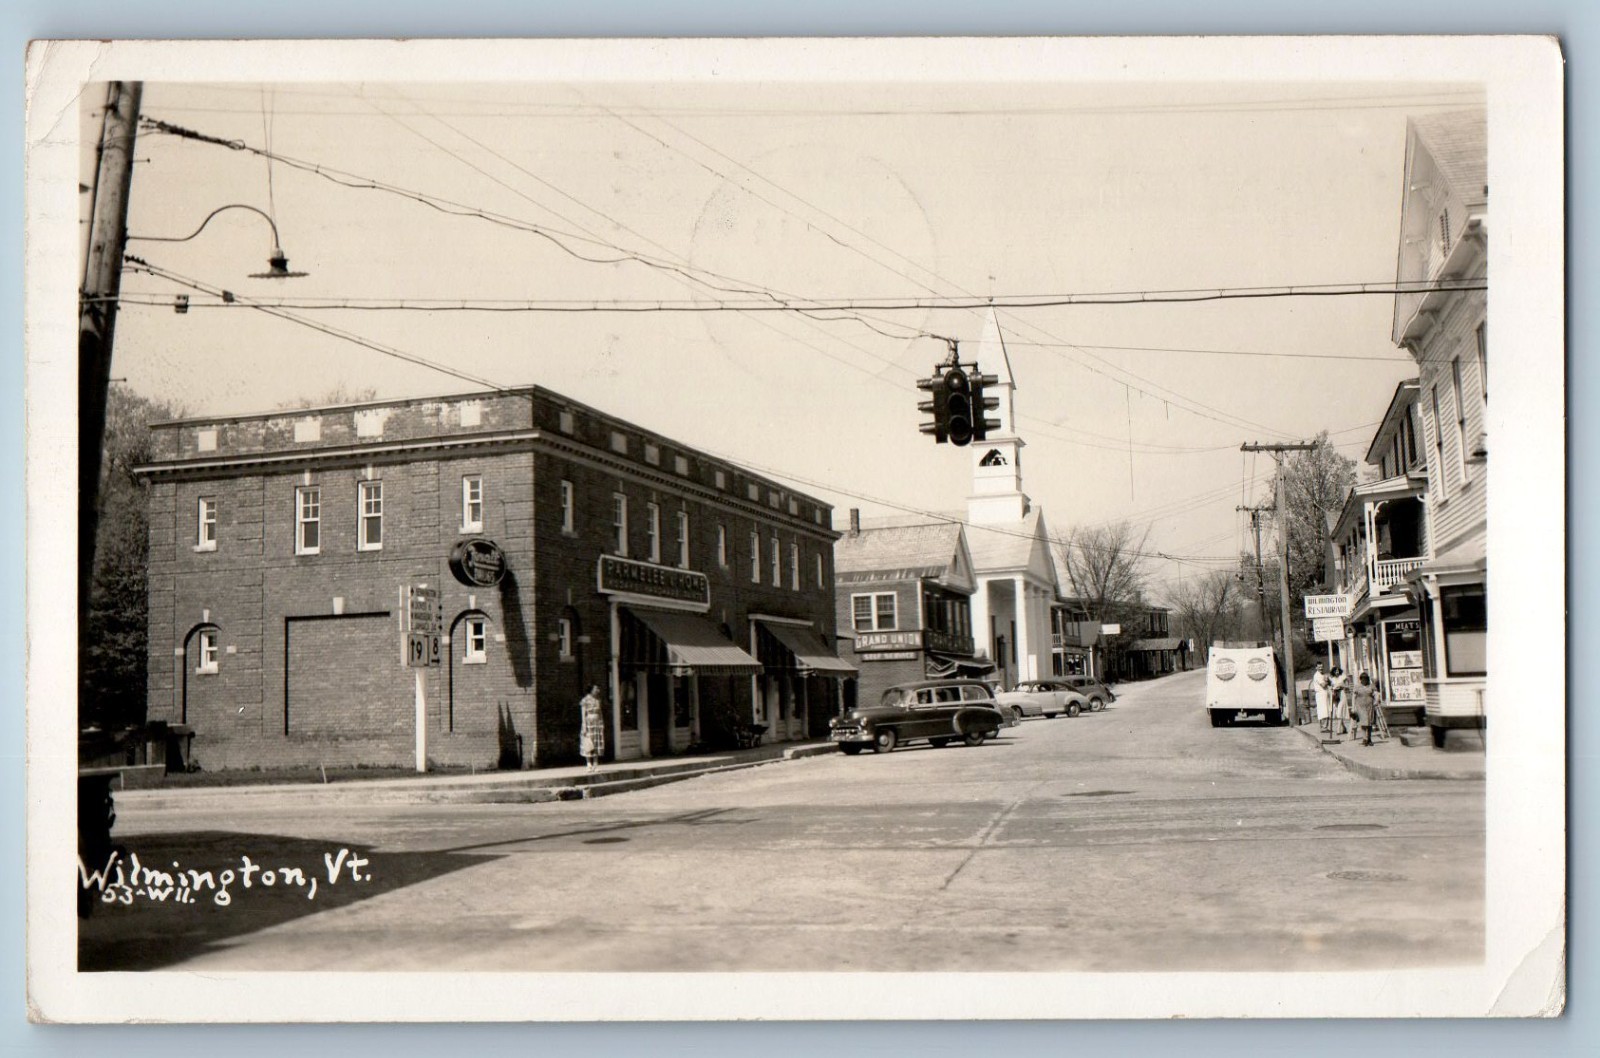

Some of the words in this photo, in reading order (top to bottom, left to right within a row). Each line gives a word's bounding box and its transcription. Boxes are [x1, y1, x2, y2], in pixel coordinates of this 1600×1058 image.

[416, 641, 423, 659] 9
[433, 637, 439, 655] 8
[856, 635, 887, 649] GRAND
[890, 633, 921, 646] UNION
